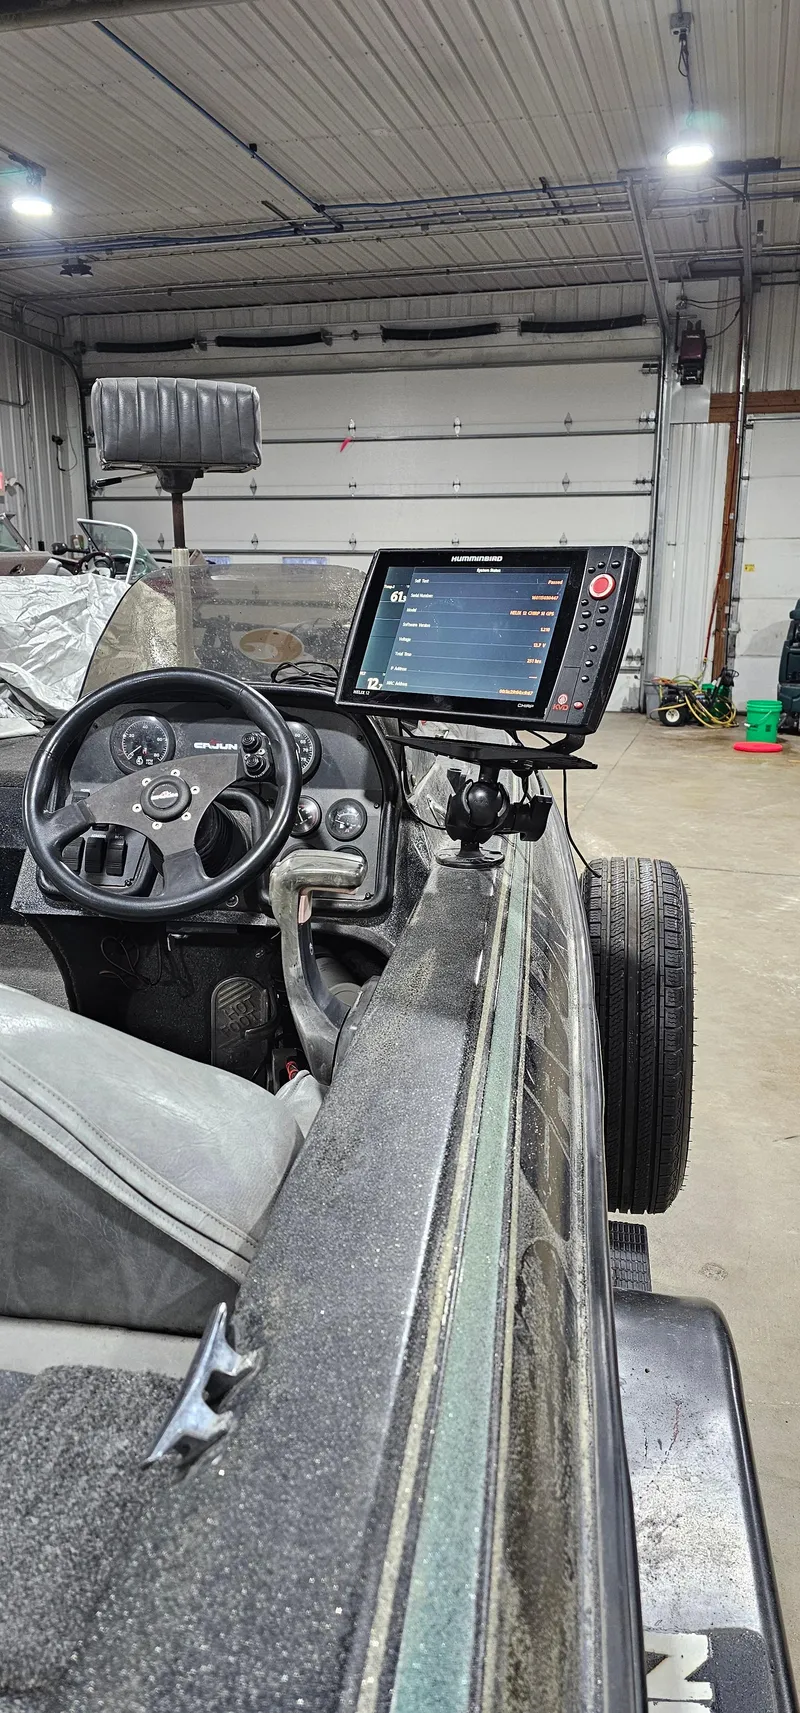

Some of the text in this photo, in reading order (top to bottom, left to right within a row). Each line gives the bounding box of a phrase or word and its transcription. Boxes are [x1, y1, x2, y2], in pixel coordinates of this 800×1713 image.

[194, 742, 238, 750] CAJUN
[223, 995, 256, 1020] HOT
[220, 1010, 260, 1037] FOOT
